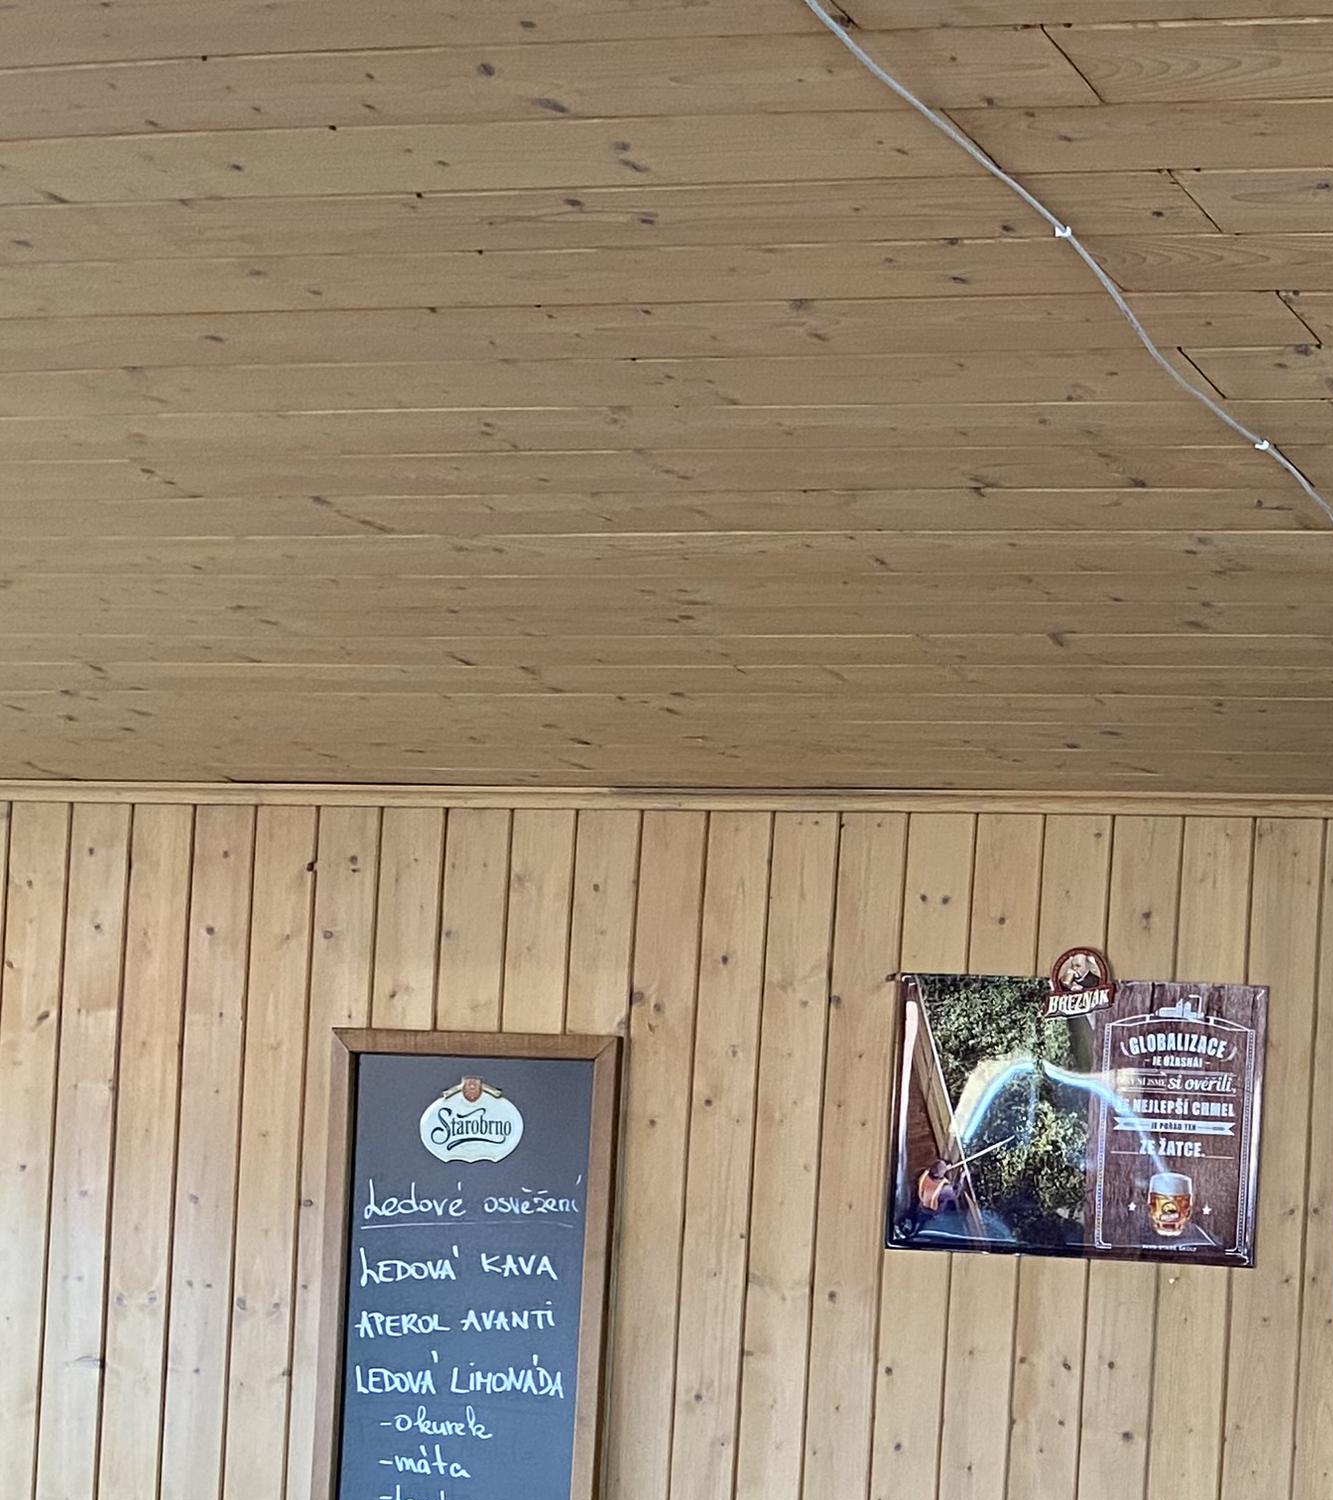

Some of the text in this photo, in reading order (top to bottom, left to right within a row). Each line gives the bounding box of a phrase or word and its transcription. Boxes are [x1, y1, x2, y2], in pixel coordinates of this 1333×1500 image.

[1128, 1032, 1228, 1058] GLOBALIZACE
[1152, 1055, 1162, 1066] JE
[1168, 1074, 1182, 1090] si
[1184, 1074, 1236, 1094] ověřili,
[1132, 1096, 1188, 1115] NEJLEPŠÍ
[1192, 1100, 1235, 1117] CHMEL
[430, 1107, 512, 1147] Starobrno
[1184, 1122, 1196, 1131] TEN
[1140, 1138, 1206, 1158] ZE ŽATCE.
[364, 1174, 582, 1220] Ledové osvěžení
[360, 1245, 460, 1288] LEDOVÁ
[354, 1310, 450, 1339] APEROL
[355, 1350, 440, 1395] LEDOVÁ
